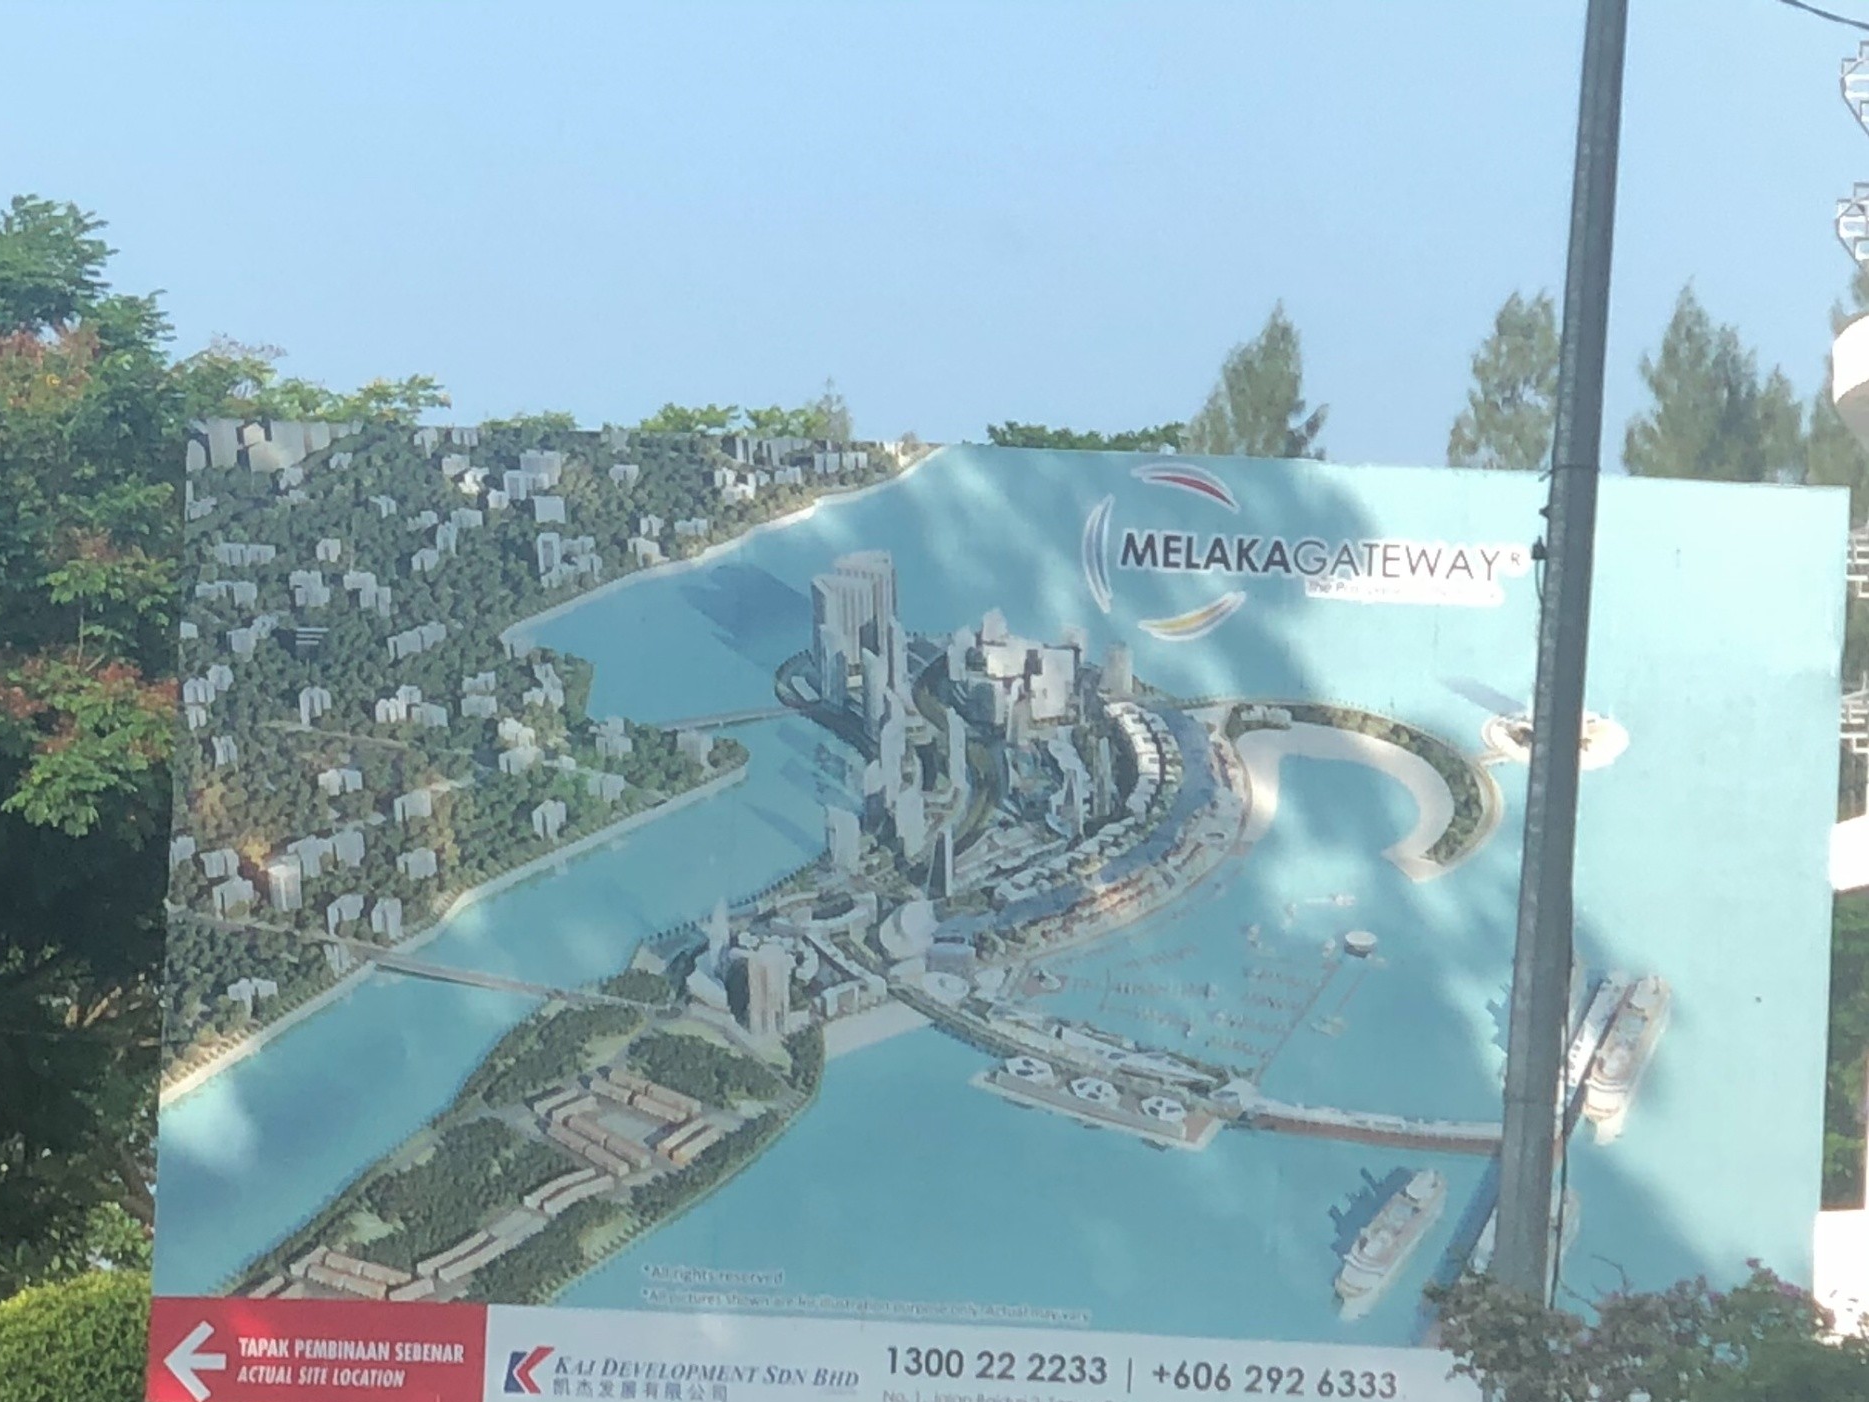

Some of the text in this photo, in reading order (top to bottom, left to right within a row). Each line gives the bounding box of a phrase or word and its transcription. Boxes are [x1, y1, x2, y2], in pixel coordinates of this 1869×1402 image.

[673, 1267, 715, 1285] rights
[238, 1337, 465, 1363] TAPAK PEMBINAAN SEBENAR
[237, 1365, 405, 1387] ACTUAL SITE LOCATION
[601, 1357, 760, 1383] DEVELOPMENT
[762, 1365, 806, 1386] SDN
[813, 1367, 860, 1388] BHD
[888, 1345, 1398, 1400] 1300 22 2233 +606 292 6333
